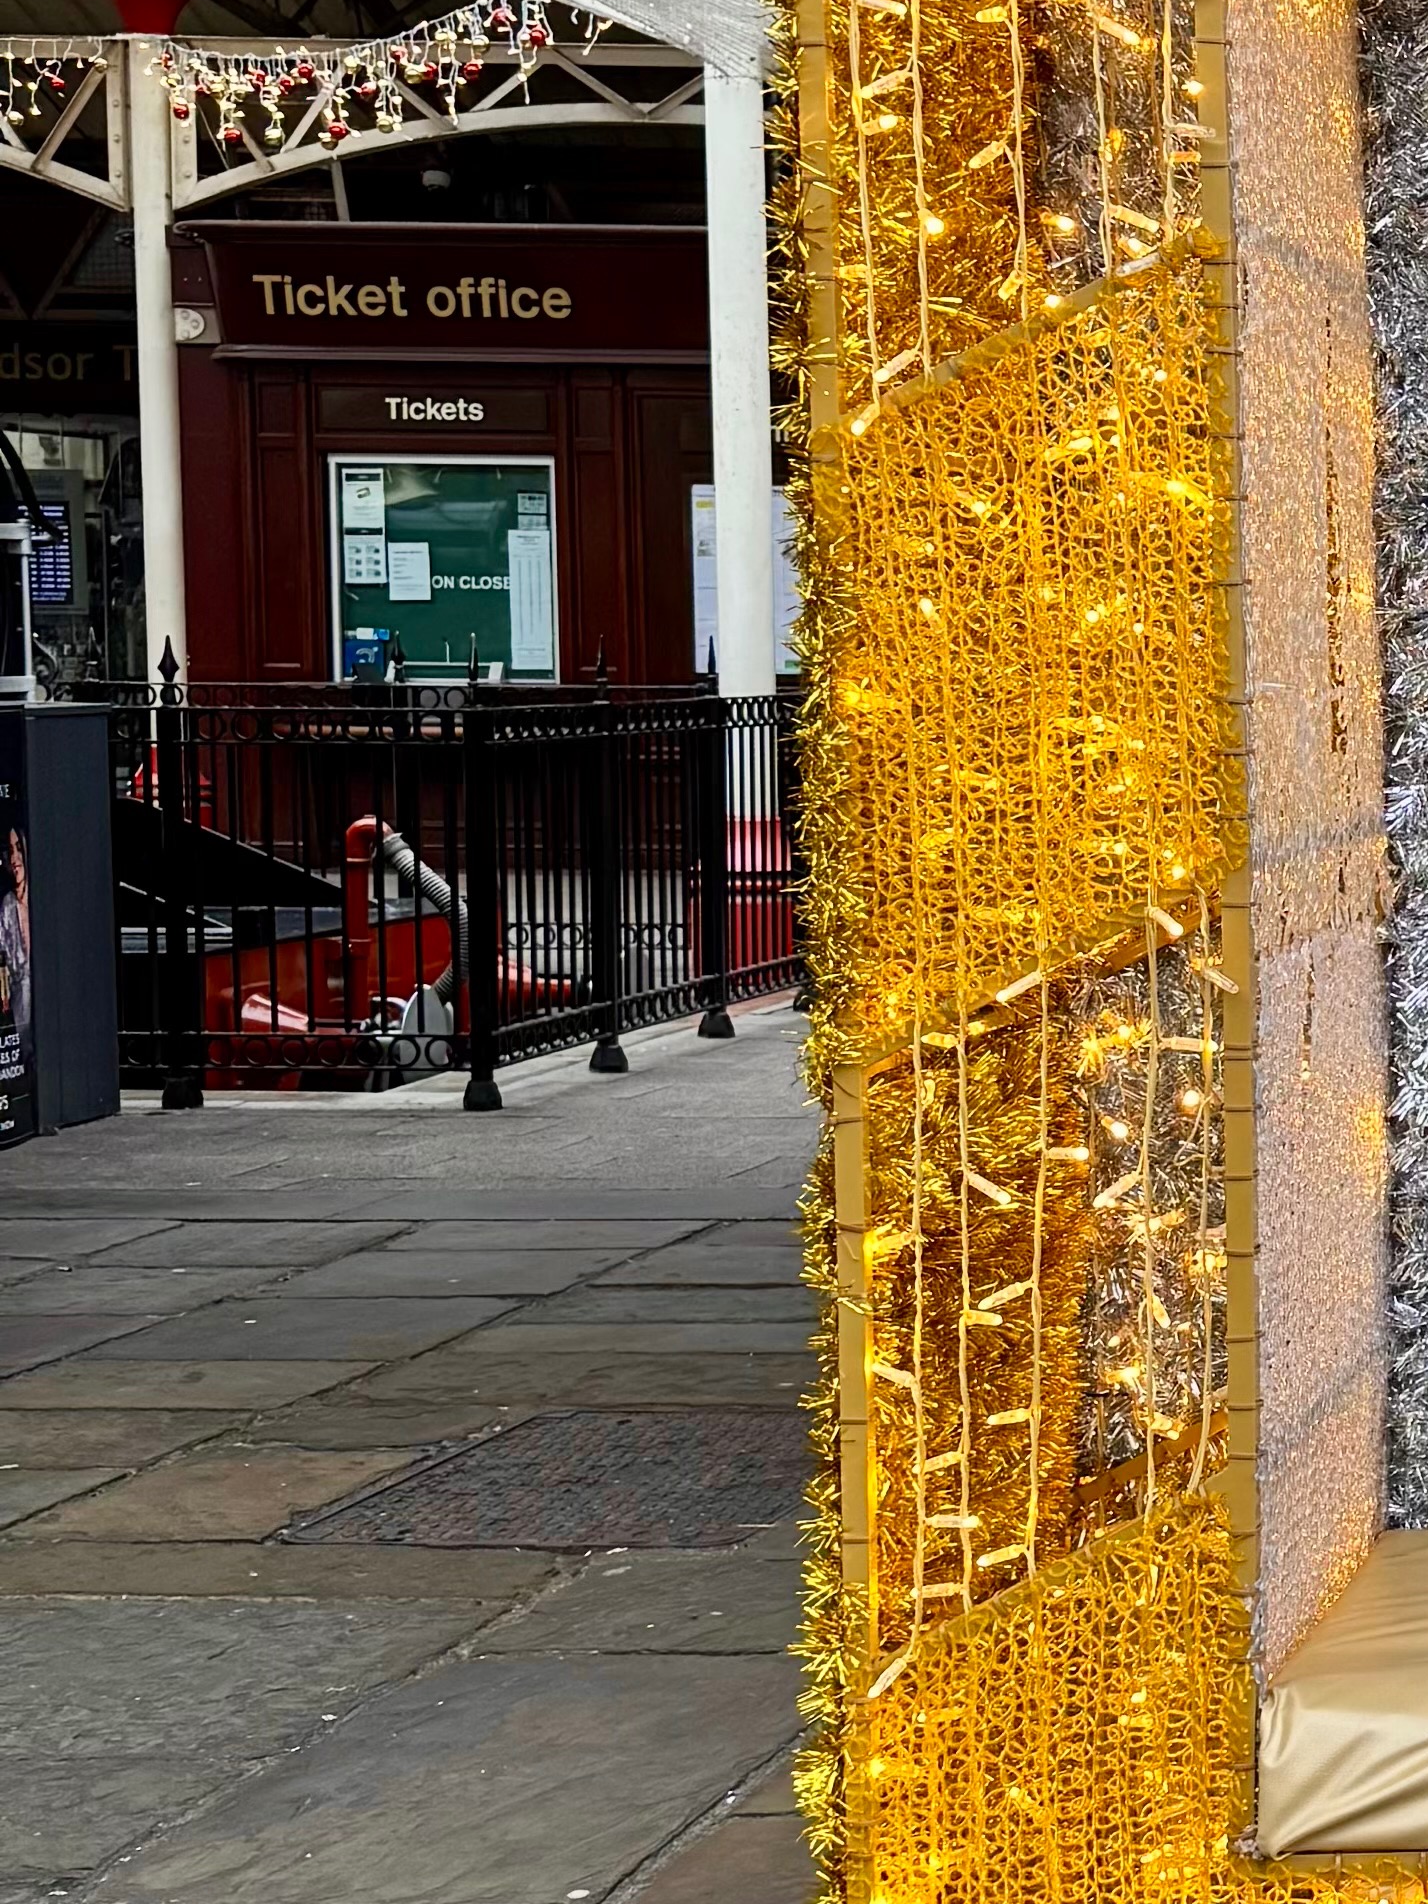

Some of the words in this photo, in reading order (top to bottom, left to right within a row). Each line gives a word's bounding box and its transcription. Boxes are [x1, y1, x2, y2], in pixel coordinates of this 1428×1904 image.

[252, 274, 408, 316] Ticket
[426, 276, 572, 319] office
[385, 397, 484, 421] Tickets
[459, 575, 511, 590] CLOSE
